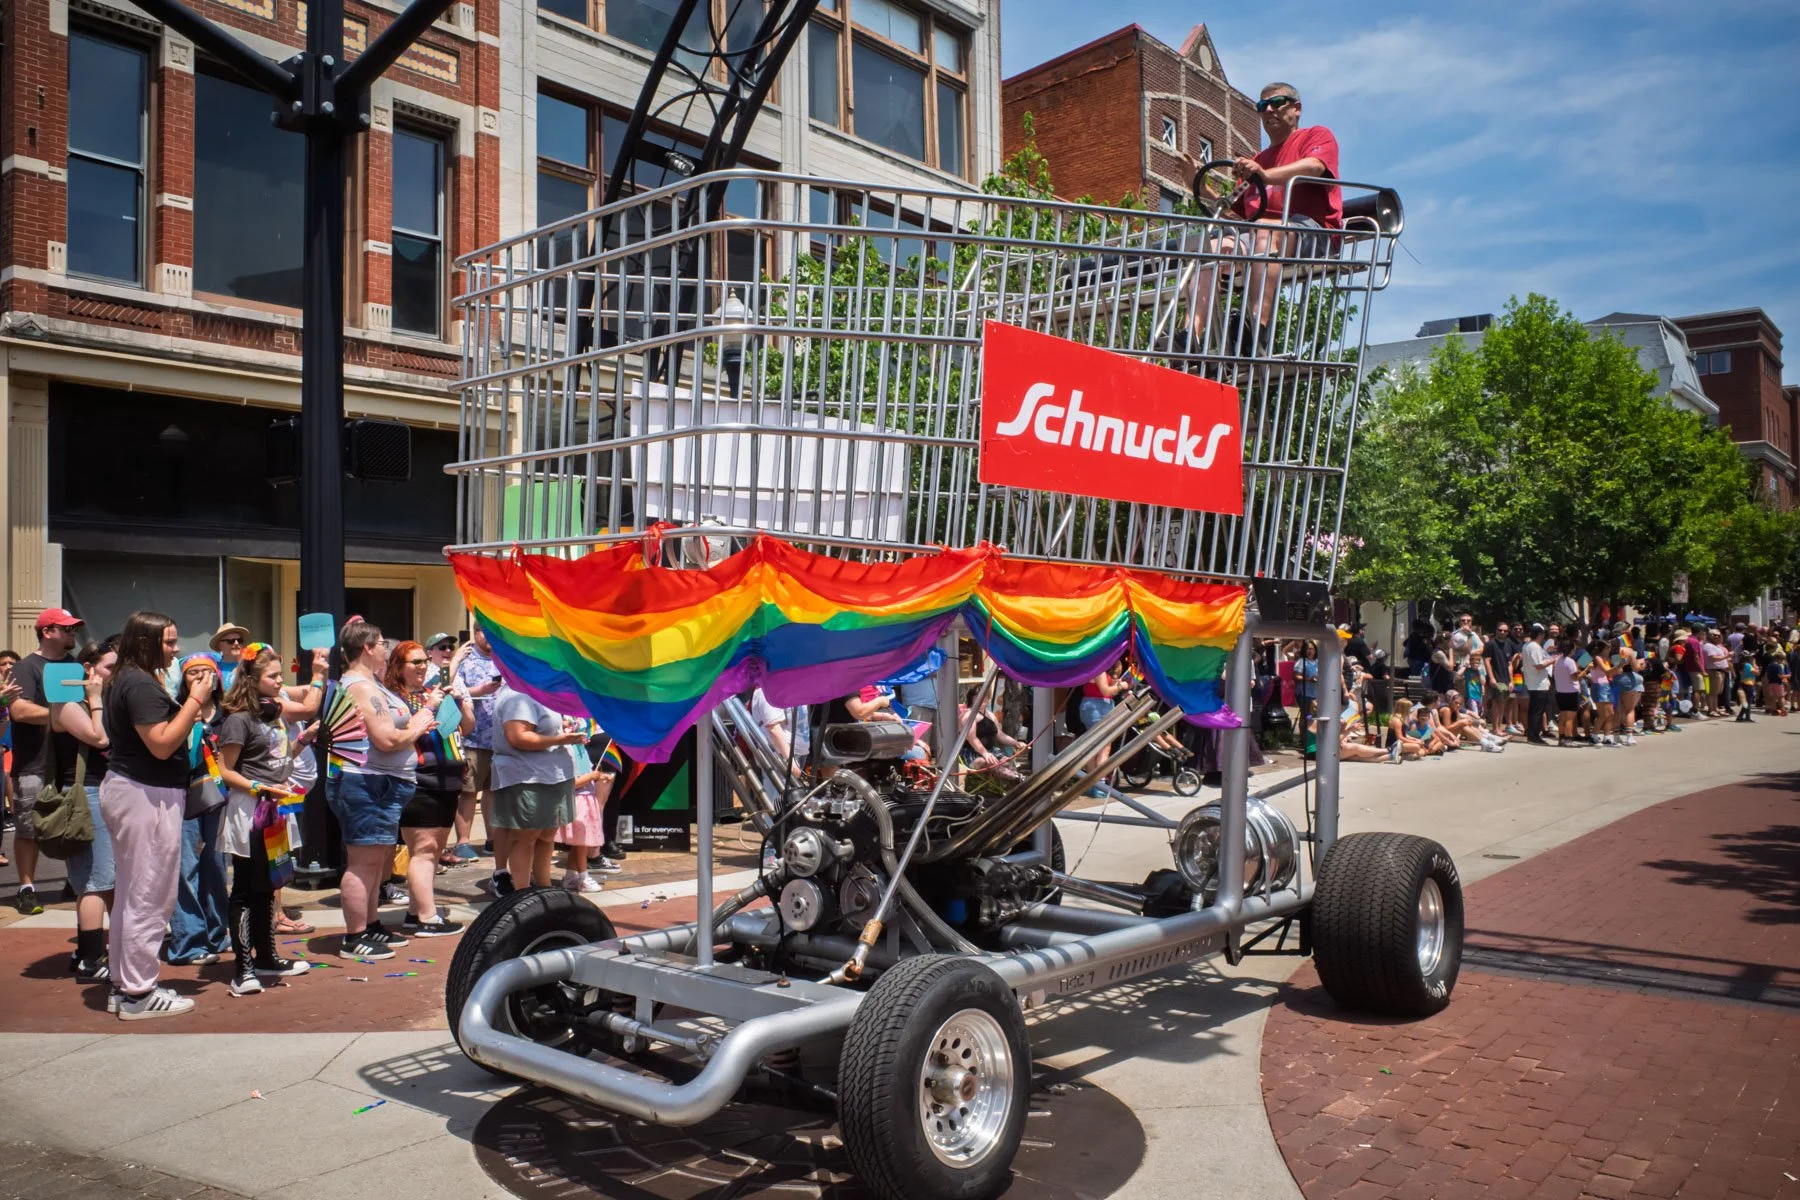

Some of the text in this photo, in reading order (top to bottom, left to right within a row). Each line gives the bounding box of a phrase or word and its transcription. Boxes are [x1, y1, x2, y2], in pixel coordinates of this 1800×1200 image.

[996, 382, 1231, 470] Schnucks
[634, 825, 640, 833] is
[641, 825, 651, 833] for
